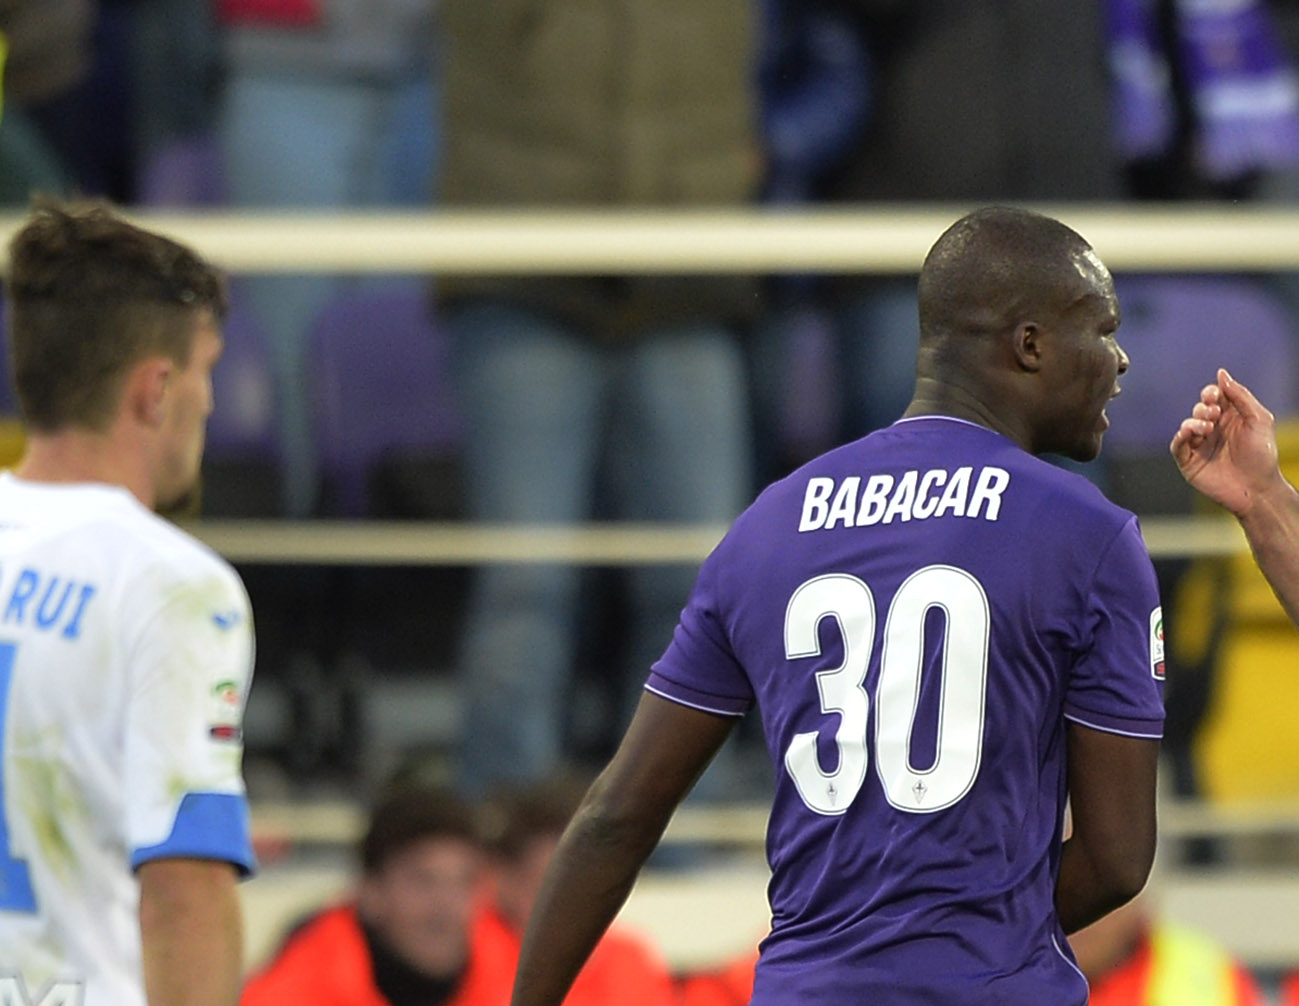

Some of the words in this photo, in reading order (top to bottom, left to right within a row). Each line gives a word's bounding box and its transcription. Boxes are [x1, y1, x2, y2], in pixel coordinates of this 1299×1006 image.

[799, 466, 1010, 533] BABACAR
[3, 567, 96, 638] RUI
[784, 564, 991, 816] 30
